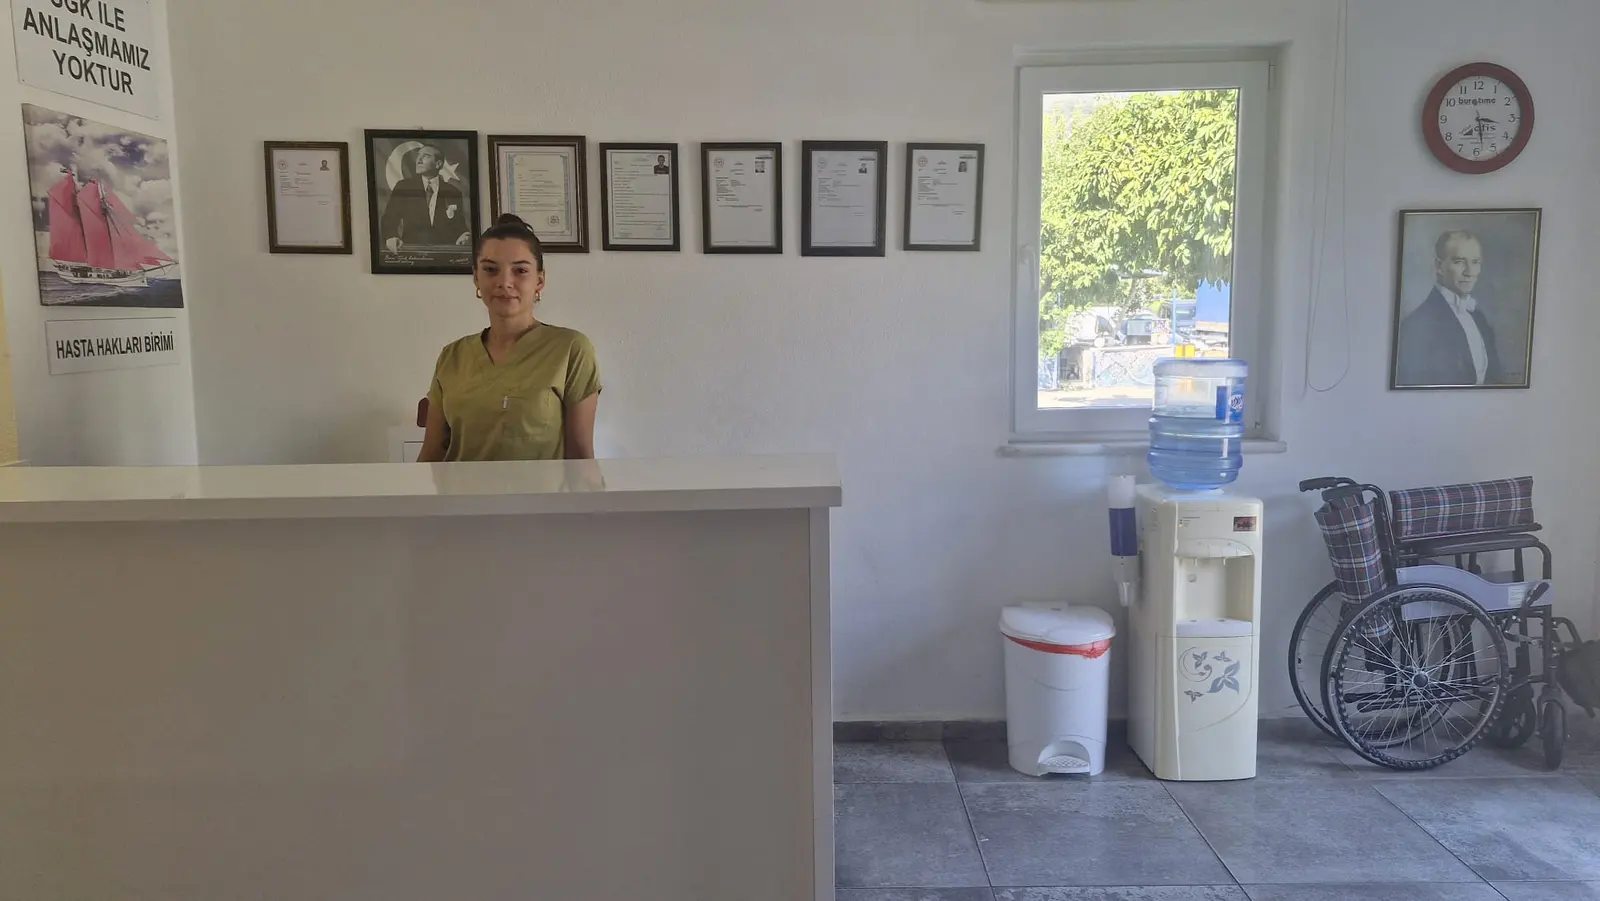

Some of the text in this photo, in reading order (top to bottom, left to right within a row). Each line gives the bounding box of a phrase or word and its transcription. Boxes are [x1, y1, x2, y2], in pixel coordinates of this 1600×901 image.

[23, 7, 151, 71] ANLAŞMAMIZ
[52, 49, 134, 95] YOKTUR
[1460, 86, 1467, 94] 11
[1474, 81, 1484, 90] 12
[1494, 85, 1497, 94] 1
[1445, 98, 1456, 107] 10
[1504, 97, 1511, 106] 2
[1440, 115, 1448, 124] 9
[1508, 114, 1515, 123] 3
[1445, 132, 1452, 141] 8
[1502, 131, 1509, 140] 4
[1457, 144, 1464, 153] 7
[1473, 147, 1480, 156] 6
[1490, 143, 1497, 152] 5
[56, 331, 174, 359] HASTA HAKLARI BİRİMİ
